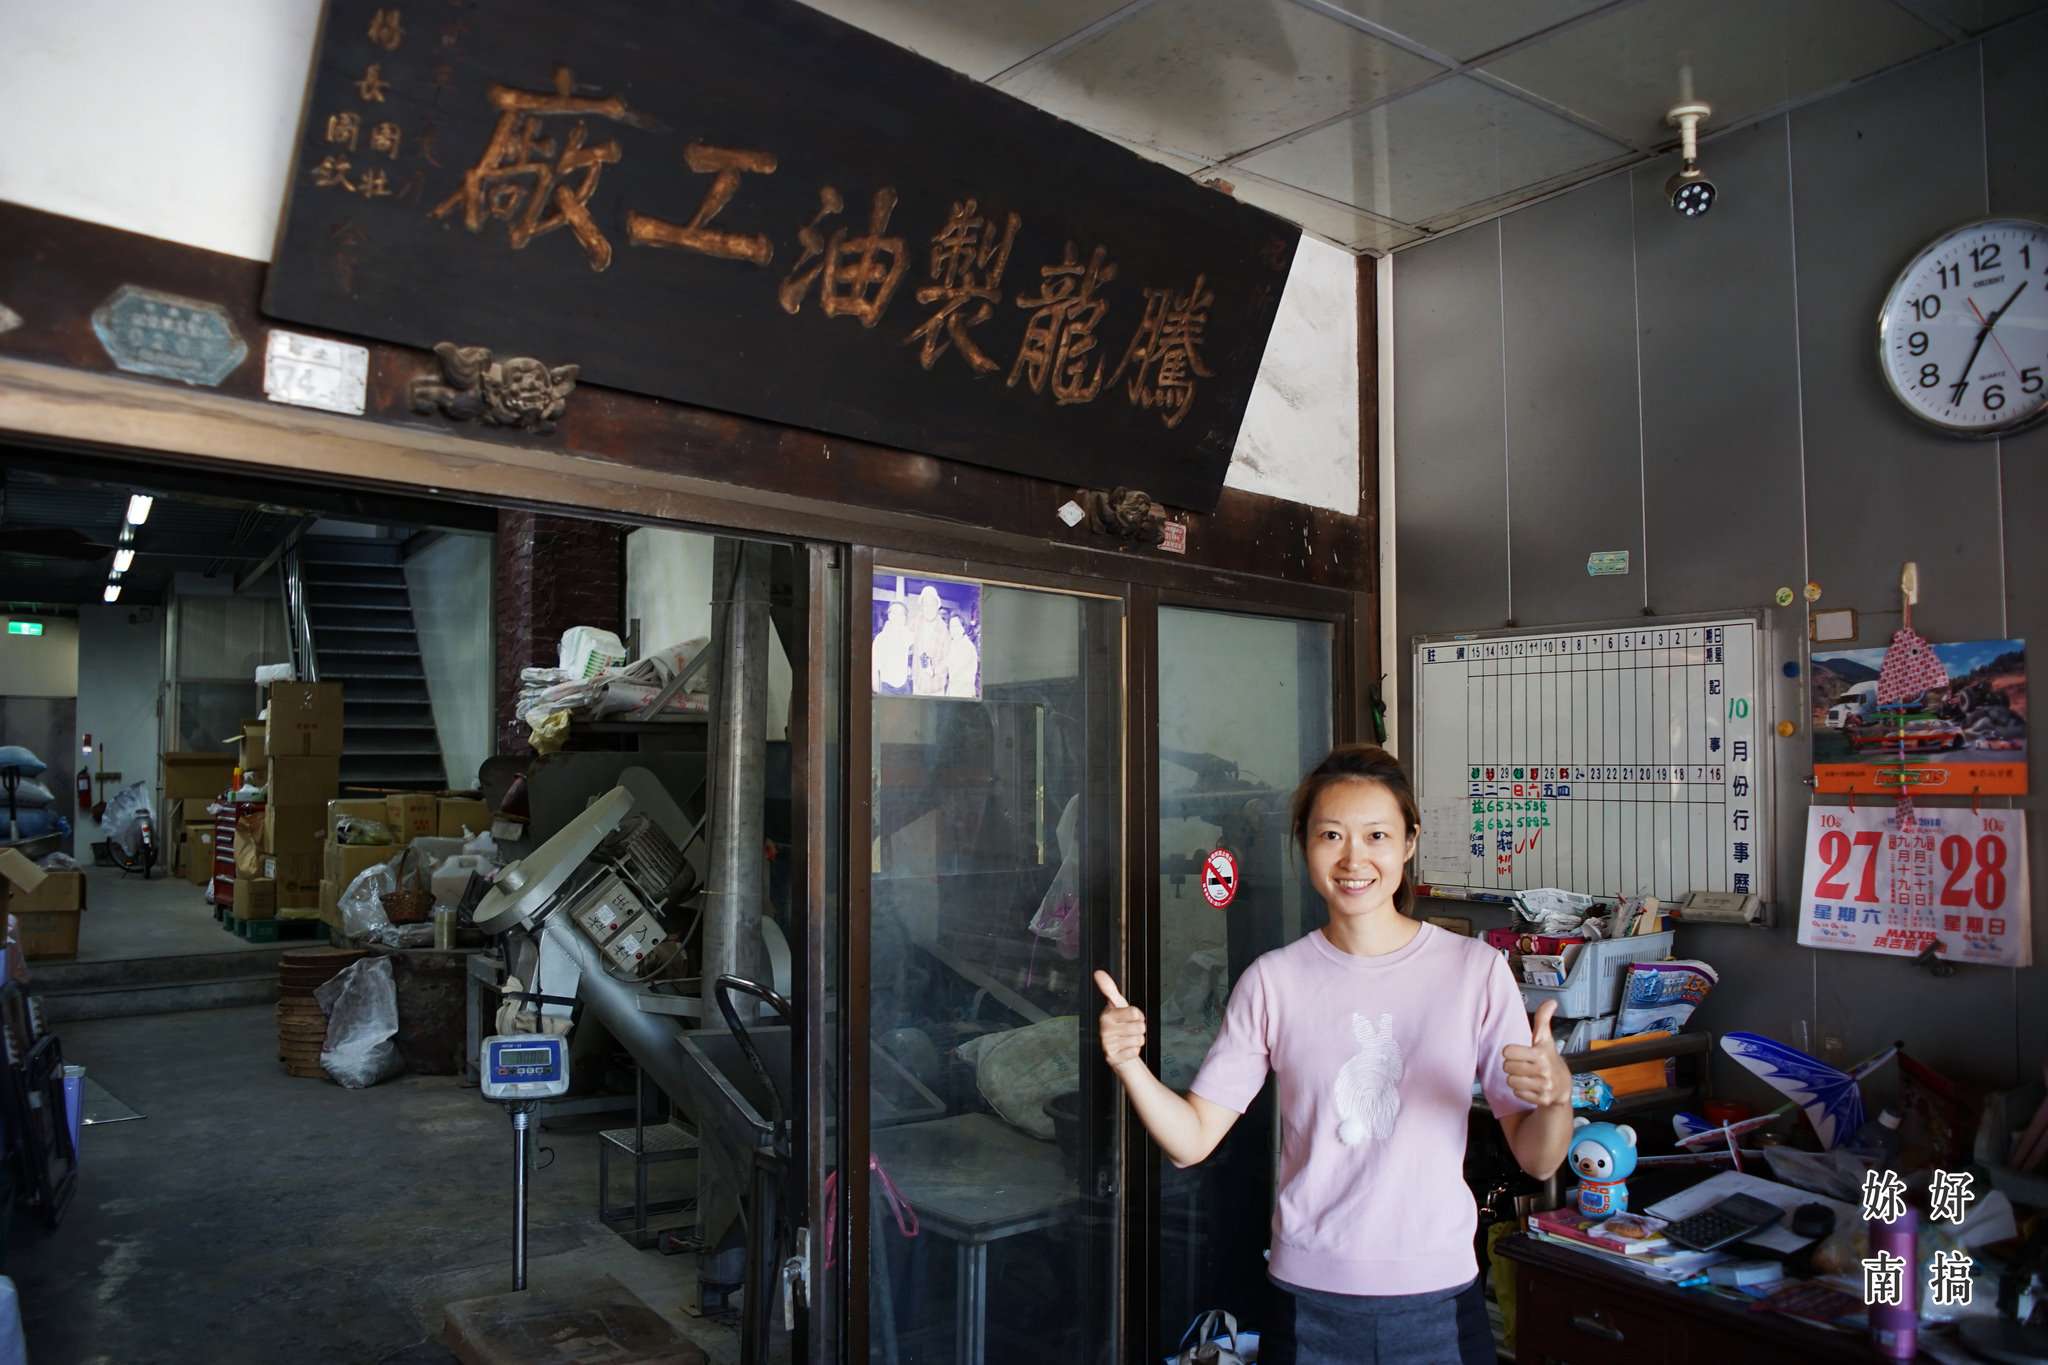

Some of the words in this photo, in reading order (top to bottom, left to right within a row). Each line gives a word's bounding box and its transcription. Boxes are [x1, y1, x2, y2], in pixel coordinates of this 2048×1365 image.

[1969, 244, 2001, 272] 12
[2019, 245, 2030, 269] 1
[1937, 263, 1959, 289] 11
[1910, 295, 1941, 322] 10
[1908, 331, 1928, 356] 9
[1919, 363, 1940, 388] 8
[2021, 367, 2044, 394] 5
[1983, 384, 2006, 411] 6
[1472, 648, 1480, 658] 15
[1486, 646, 1495, 656] 14
[1500, 644, 1509, 656] 13
[1514, 642, 1523, 655] 12
[1544, 641, 1553, 653] 10
[1561, 640, 1566, 652] 9
[1576, 639, 1582, 651] 8
[1608, 637, 1613, 649] 6
[1625, 636, 1630, 647] 5
[1641, 635, 1646, 645] 4
[1658, 633, 1664, 646] 3
[1675, 632, 1681, 645] 2
[1729, 697, 1749, 723] 10
[1500, 767, 1509, 779] 29
[1544, 767, 1554, 779] 26
[1590, 768, 1601, 779] 23
[1606, 768, 1617, 780] 22
[1623, 769, 1633, 780] 21
[1639, 769, 1650, 780] 20
[1656, 769, 1667, 780] 19
[1673, 769, 1684, 781] 18
[1709, 769, 1721, 781] 16
[1469, 783, 1483, 797] 三
[1485, 785, 1498, 796] 二
[1513, 784, 1524, 797] 日
[1814, 830, 1883, 904] 27
[1897, 836, 1911, 906] 九月十九日
[1913, 836, 1927, 907] 九月二十日
[1939, 834, 2007, 911] 28
[1813, 904, 1881, 925] 星期六
[1943, 914, 2006, 936] 星期日
[1886, 928, 1937, 940] MAXXIS
